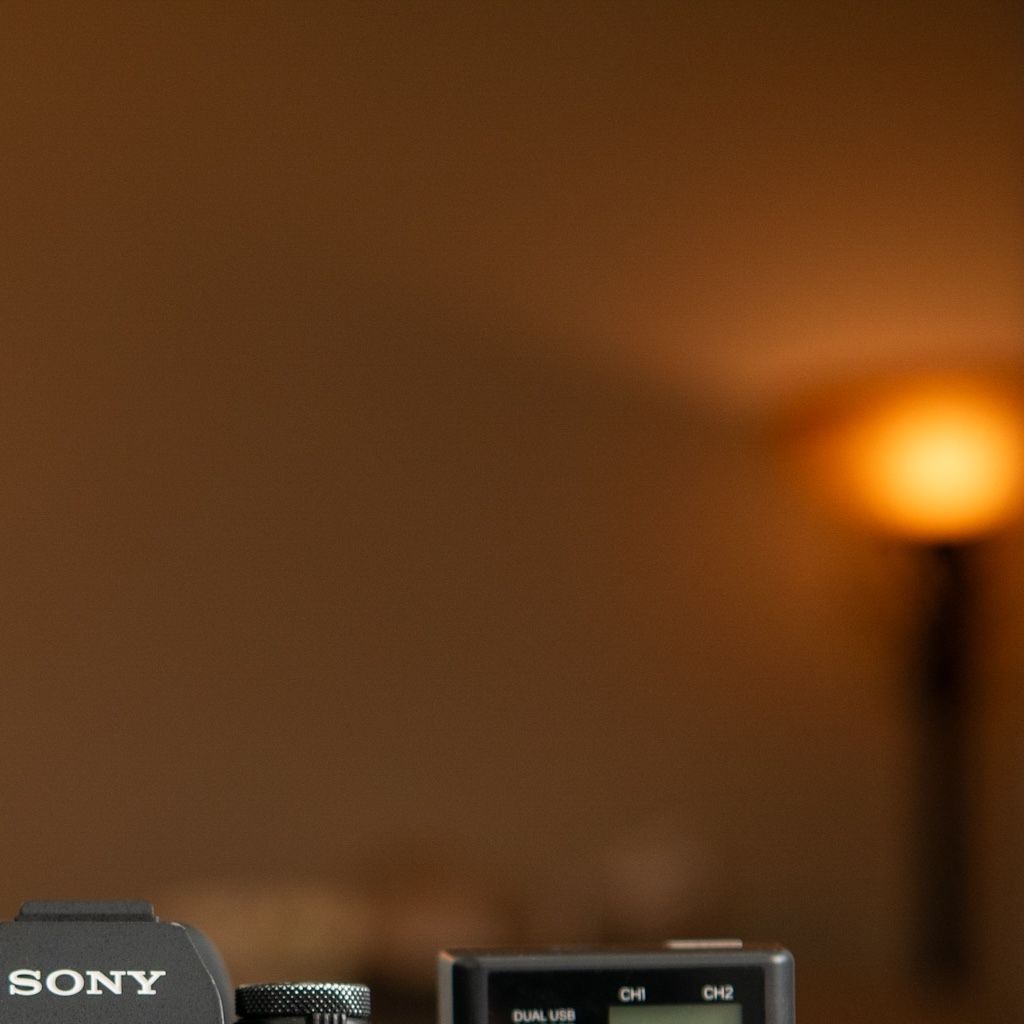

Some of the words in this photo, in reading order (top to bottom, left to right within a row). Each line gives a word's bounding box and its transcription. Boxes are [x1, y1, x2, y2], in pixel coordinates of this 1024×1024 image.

[8, 969, 166, 996] SONY
[619, 987, 646, 1001] CH1
[701, 985, 734, 1000] CH2
[512, 1009, 547, 1022] DUAL
[550, 1008, 576, 1022] USB
